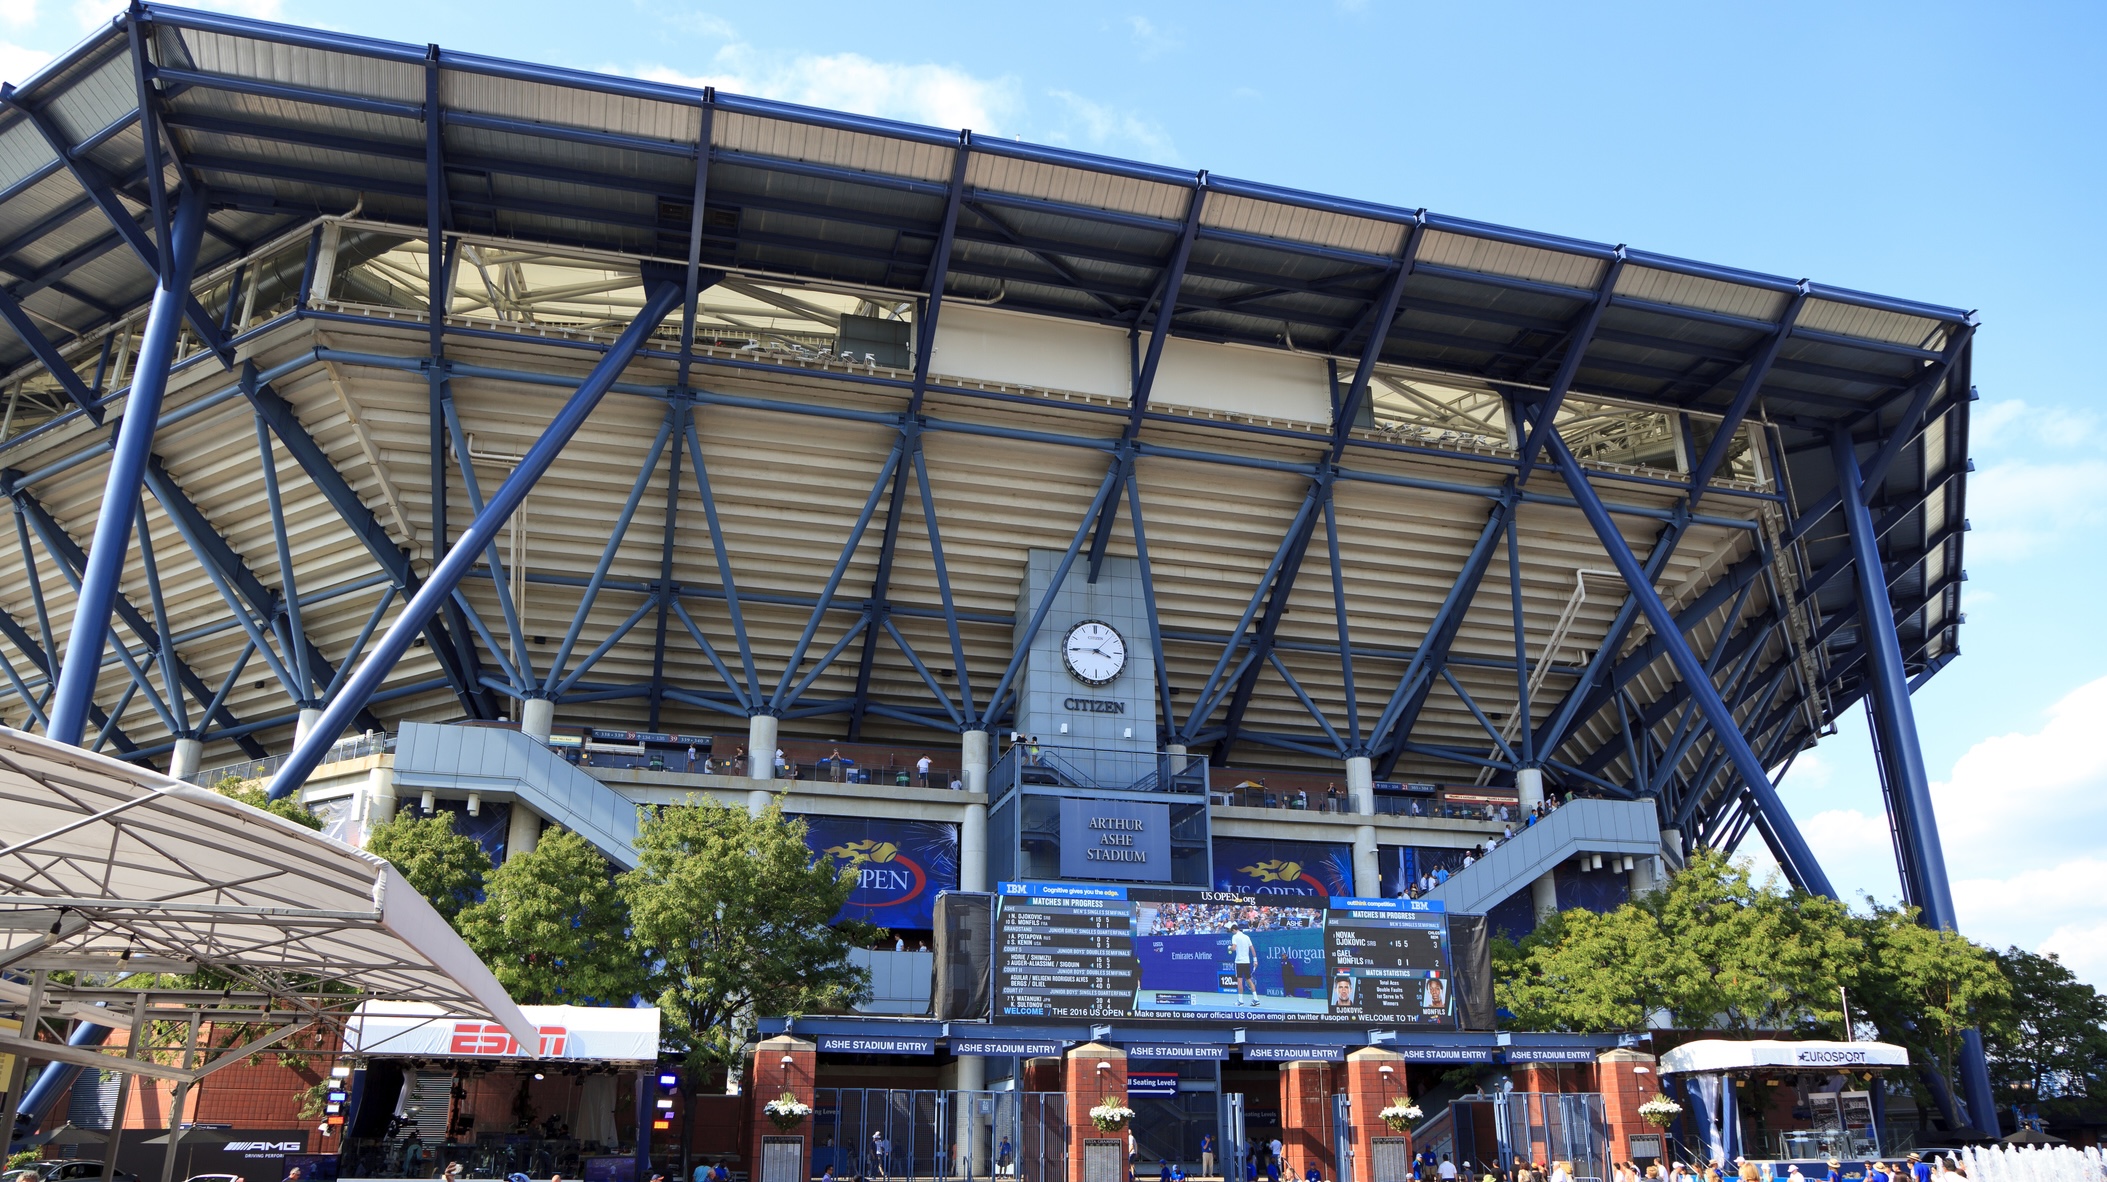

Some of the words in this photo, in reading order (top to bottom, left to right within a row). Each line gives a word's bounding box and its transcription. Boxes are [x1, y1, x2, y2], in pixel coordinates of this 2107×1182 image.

[1064, 698, 1125, 713] CITIZEN
[1089, 817, 1143, 830] ARTHUR
[1100, 834, 1133, 846] ASHE
[1087, 848, 1146, 862] STADIUM
[1007, 884, 1027, 894] IBM
[1043, 887, 1068, 895] Cognitive
[1201, 892, 1212, 901] US
[1214, 893, 1239, 901] OPEN
[1033, 898, 1061, 906] MATCHES
[1071, 900, 1103, 908] PROGRESS
[1411, 901, 1429, 910] IBM
[1172, 952, 1193, 960] Emirates
[1266, 946, 1326, 963] J.P.Morgan
[1337, 957, 1364, 965] MONFILS
[1221, 976, 1232, 985] 120
[1004, 1007, 1044, 1015] WELCOME
[1070, 1008, 1088, 1016] 2016
[825, 1041, 851, 1049] ASHE
[852, 1041, 895, 1050] STADIUM
[897, 1042, 927, 1051] ENTRY
[958, 1044, 982, 1052] ASHE
[984, 1044, 1025, 1053] STADIUM
[1027, 1045, 1056, 1054] ENTRY
[1131, 1047, 1153, 1055] ASHE
[1156, 1048, 1193, 1056] STADIUM
[1195, 1048, 1223, 1057] ENTRY
[1250, 1049, 1272, 1057] ASHE
[1312, 1050, 1338, 1058] ENTRY
[1404, 1050, 1425, 1058] ASHE
[1426, 1050, 1460, 1059] STADIUM
[1462, 1051, 1486, 1059] ENTRY
[1511, 1051, 1531, 1059] ASHE
[1533, 1051, 1565, 1059] STADIUM
[1804, 1052, 1865, 1062] EUROSPORT
[1133, 1079, 1156, 1087] Seating
[247, 1142, 300, 1150] AMG
